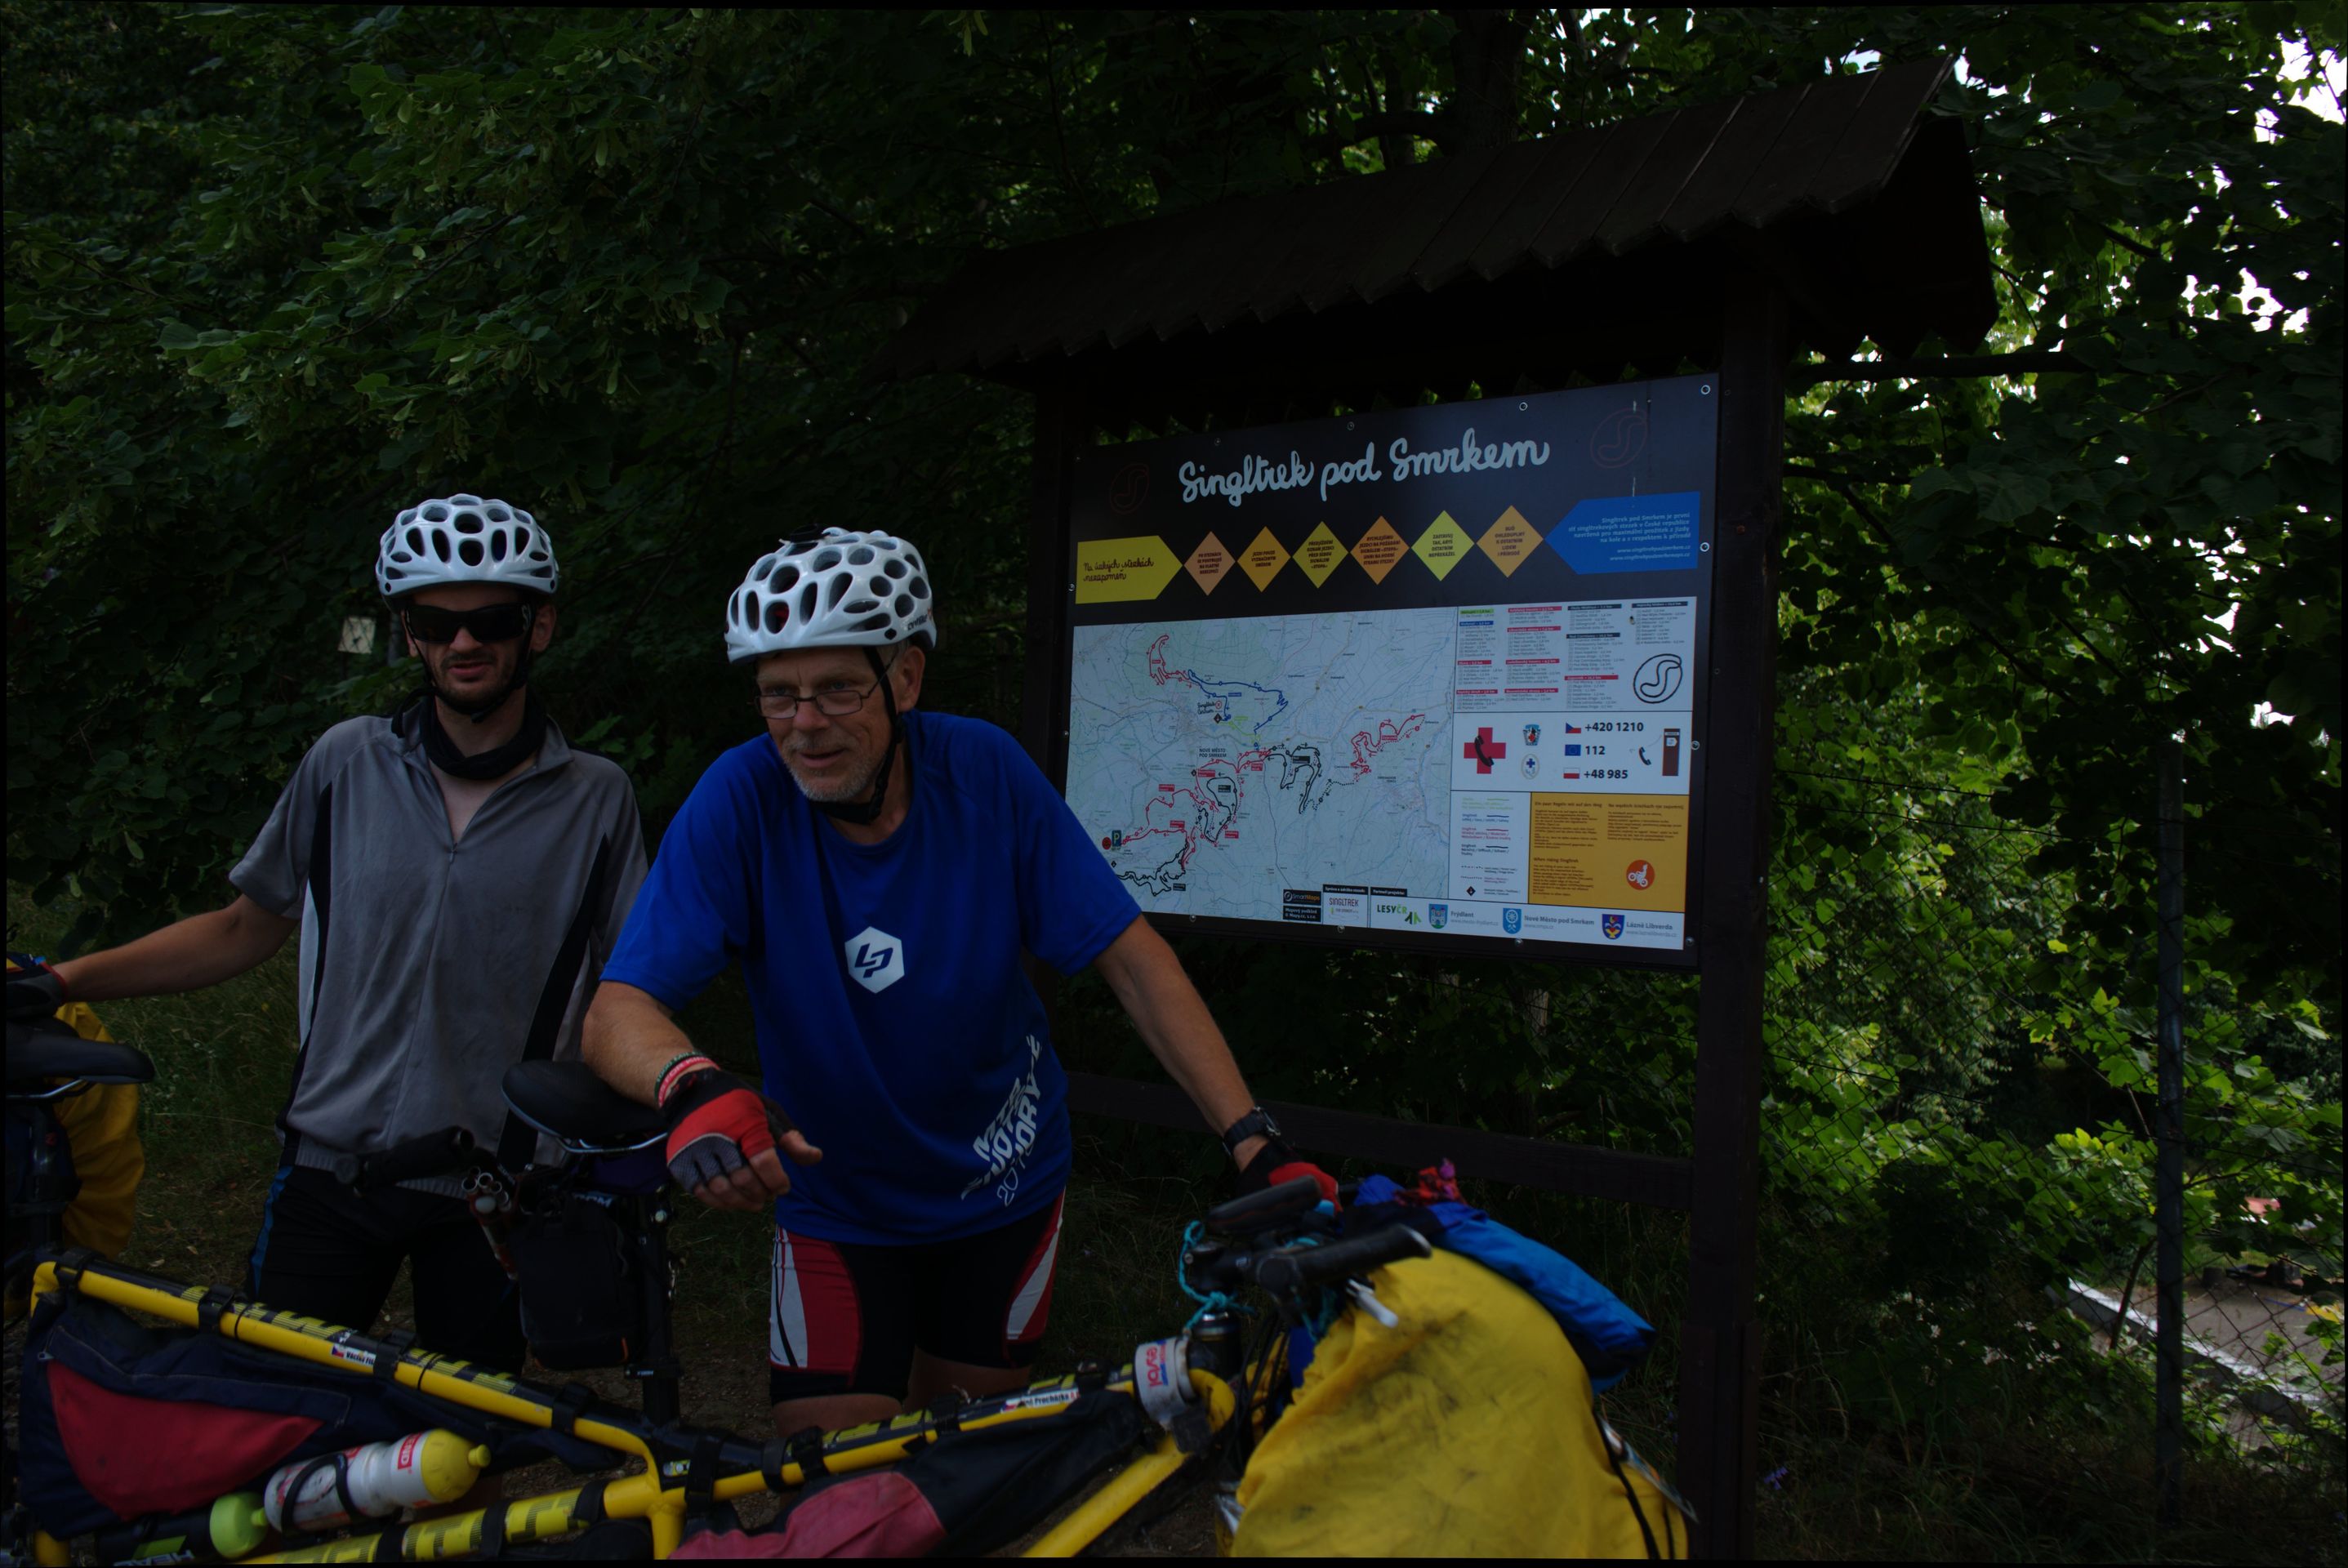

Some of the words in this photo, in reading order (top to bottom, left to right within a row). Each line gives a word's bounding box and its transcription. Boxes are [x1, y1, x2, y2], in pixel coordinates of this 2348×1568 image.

[1178, 450, 1314, 507] Singltrek
[1320, 441, 1382, 502] pod
[1388, 427, 1550, 482] Smrkem
[1585, 722, 1613, 732] +420
[1616, 722, 1644, 732] 1210
[1585, 746, 1606, 755] 112
[1584, 769, 1605, 779] +48
[1607, 769, 1628, 779] 985
[1329, 898, 1359, 907] SINGLTREK
[1539, 915, 1557, 924] Město
[1646, 922, 1673, 930] Libverda
